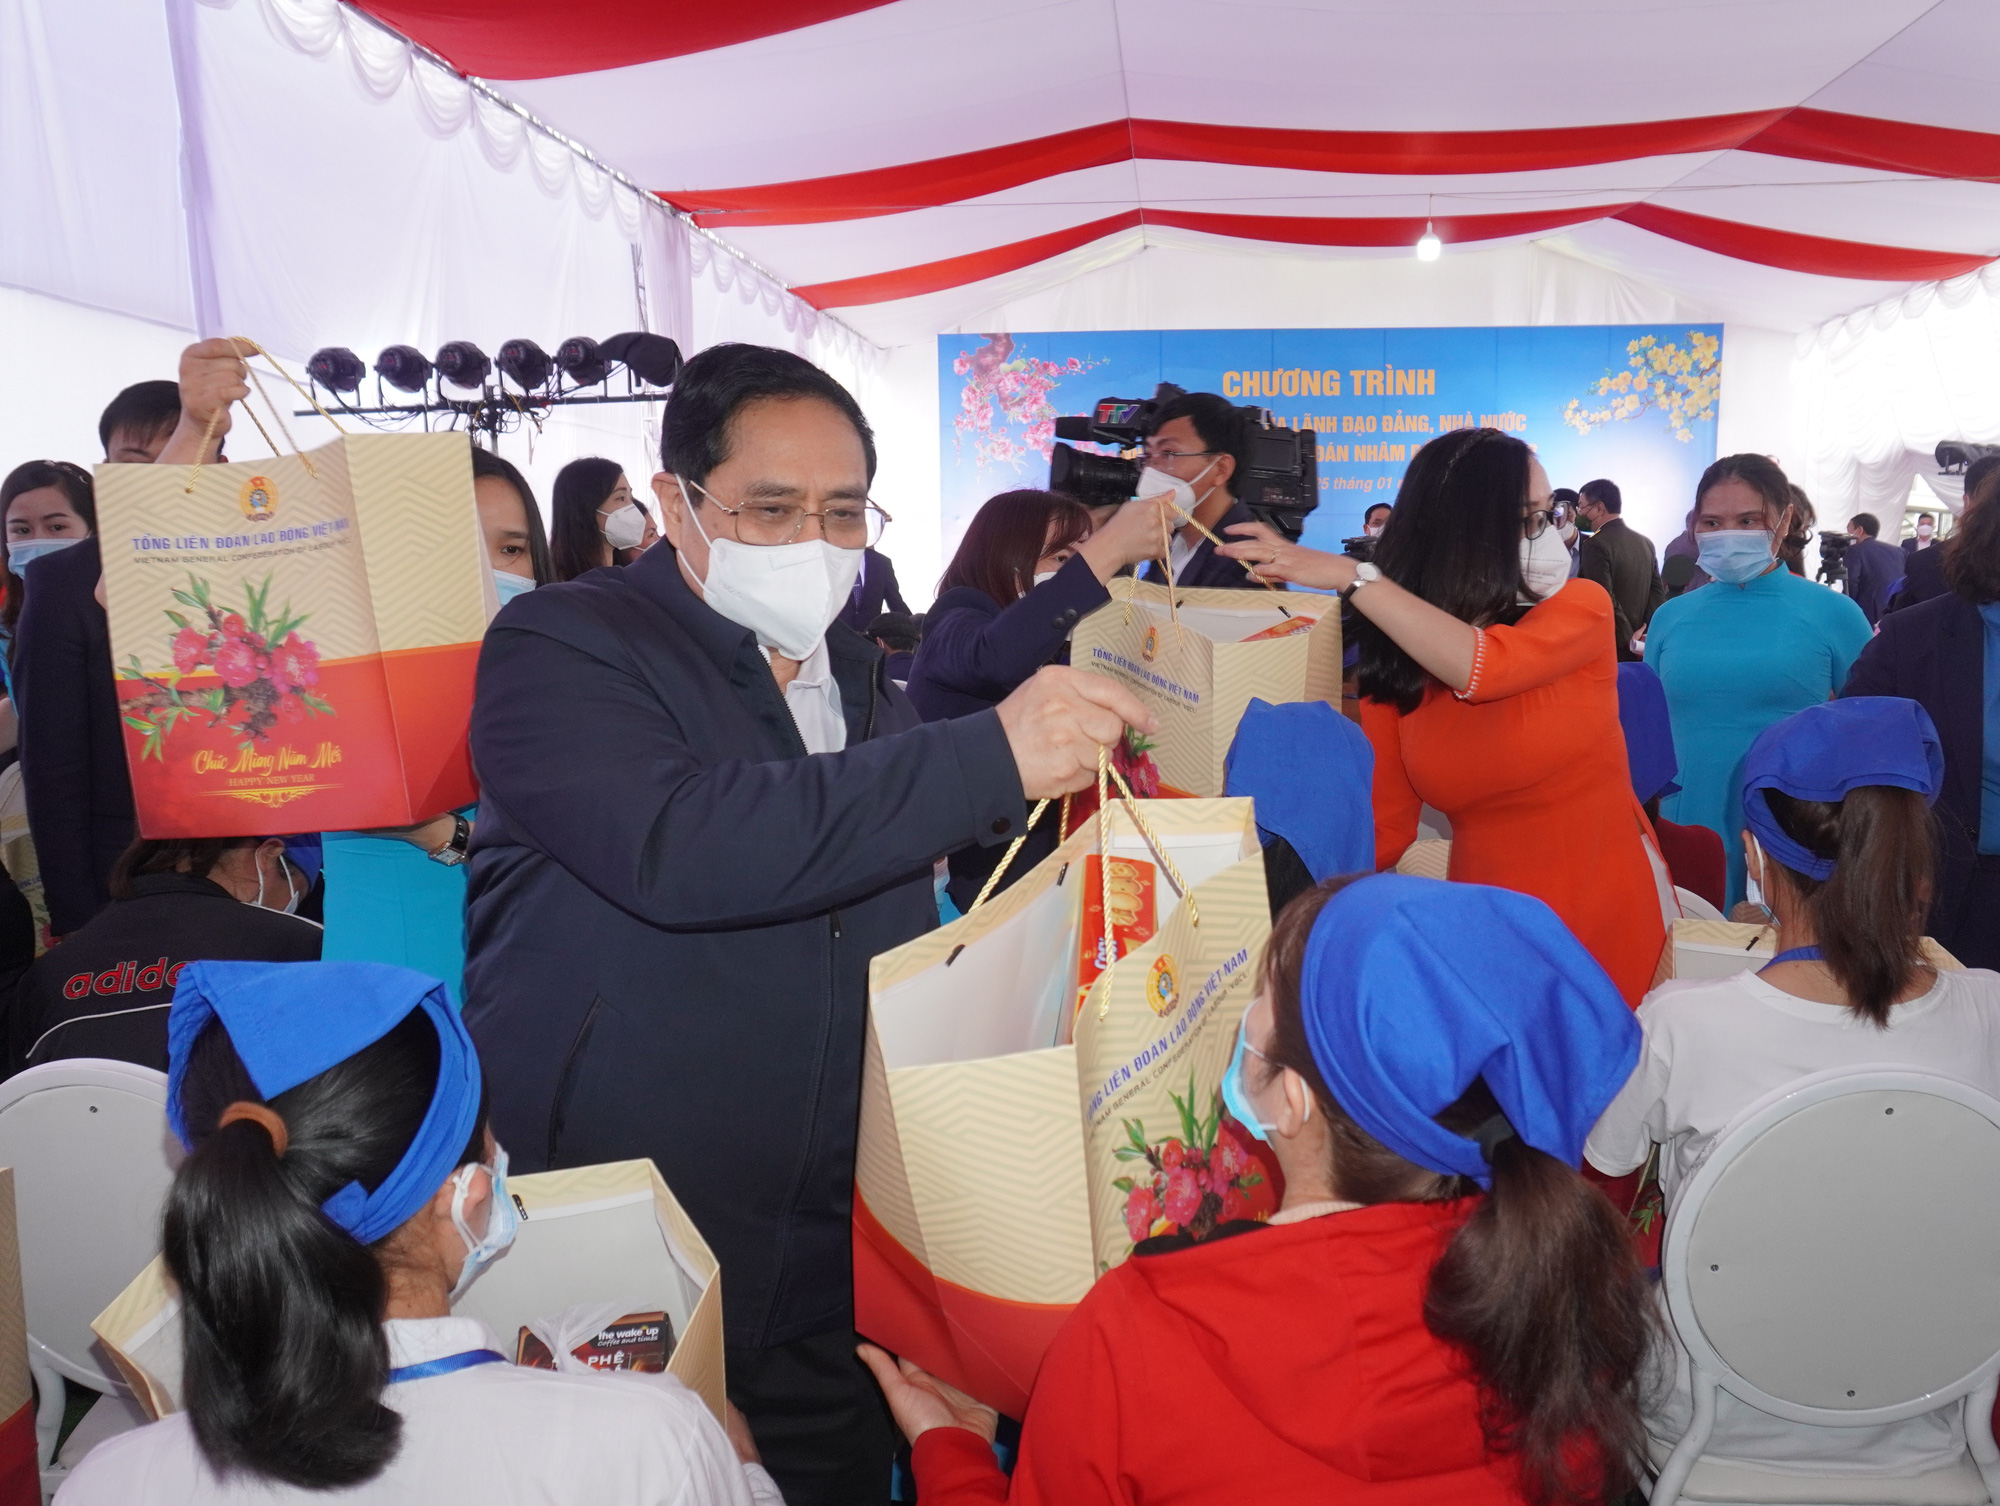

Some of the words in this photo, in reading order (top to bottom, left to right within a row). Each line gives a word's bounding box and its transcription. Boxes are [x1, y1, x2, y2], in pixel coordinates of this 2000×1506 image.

[1222, 367, 1341, 397] CHƯƠNG
[1350, 363, 1435, 396] TRÌNH
[1098, 403, 1140, 424] TTV
[1293, 413, 1337, 433] LÃNH
[1342, 415, 1377, 436] ĐẠO
[1382, 409, 1434, 434] ĐẢNG,
[1439, 411, 1475, 432] NHÀ
[1480, 411, 1527, 432] NƯỚC
[1354, 441, 1406, 462] NHÂM
[1333, 476, 1373, 492] tháng
[1377, 476, 1393, 489] 01
[132, 532, 171, 550] TỔNG
[175, 534, 209, 549] LIÊN
[215, 533, 250, 549] ĐOÀN
[253, 532, 275, 546] LAO
[280, 527, 309, 544] ĐỘNG
[312, 521, 333, 538] VIỆT
[134, 556, 179, 564] VIETNAM
[182, 555, 229, 563] GENERAL
[1092, 646, 1113, 662] TỔNG
[1183, 689, 1200, 704] NAM
[229, 777, 263, 787] HAPPY
[266, 775, 288, 785] NEW
[291, 774, 315, 783] YEAR
[63, 957, 197, 999] adid
[1104, 1065, 1131, 1097] LIÊN
[1134, 1037, 1168, 1072] ĐOÀN
[1169, 1018, 1187, 1045] LAO
[1187, 991, 1205, 1023] ĐỘNG
[1204, 969, 1222, 997] VIỆT
[1223, 949, 1248, 976] NAM
[1112, 1077, 1151, 1111] GENERAL
[598, 1331, 615, 1341] the
[616, 1327, 643, 1339] wake
[646, 1327, 659, 1336] up
[587, 1350, 625, 1367] PHÊ
